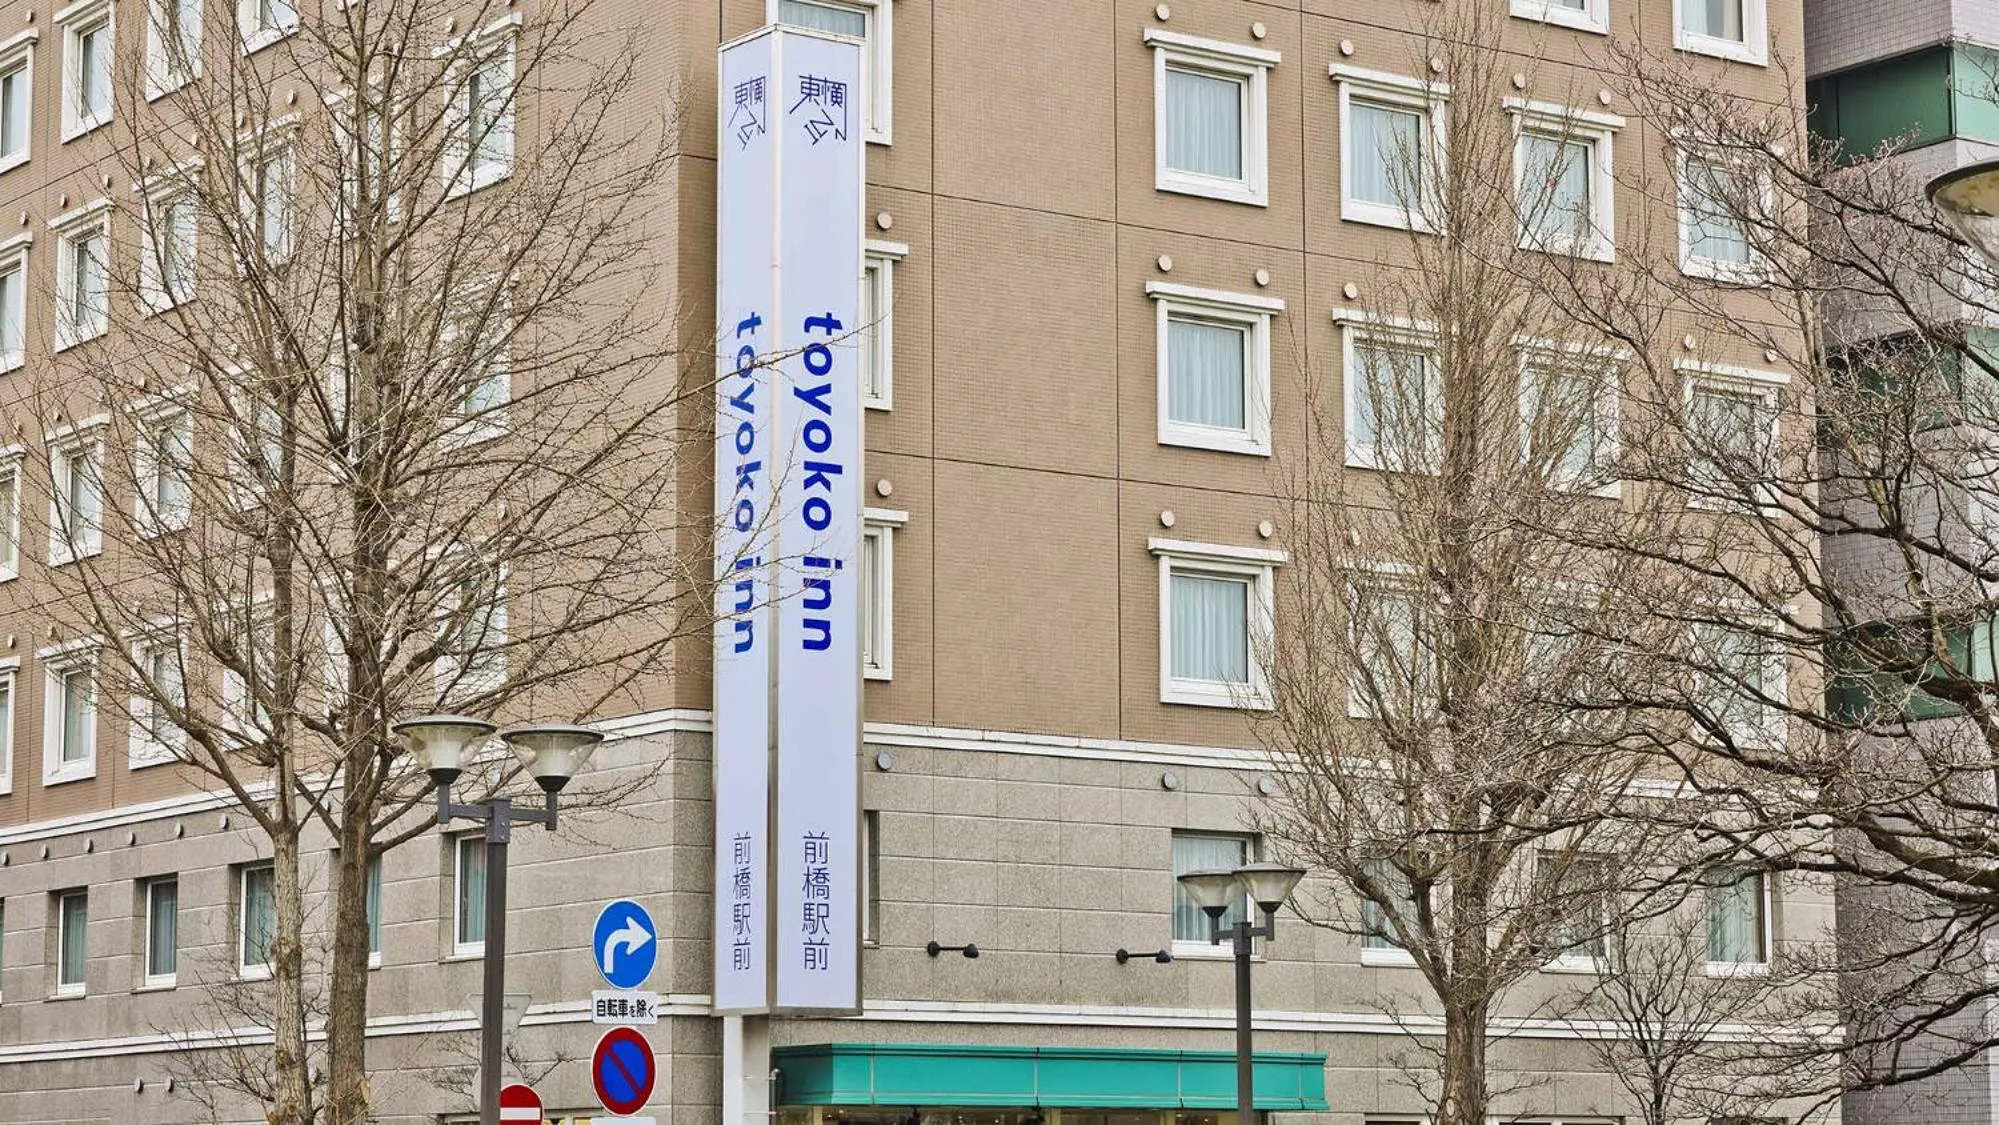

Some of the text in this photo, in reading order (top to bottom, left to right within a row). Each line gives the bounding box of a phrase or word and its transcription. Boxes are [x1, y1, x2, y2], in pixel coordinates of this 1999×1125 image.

[730, 312, 762, 653] toyoko inn
[794, 312, 843, 651] toyoko inn
[732, 831, 752, 971] 前橋駅前
[801, 830, 830, 971] 前橋駅前
[596, 999, 654, 1018] 自転車を除く
